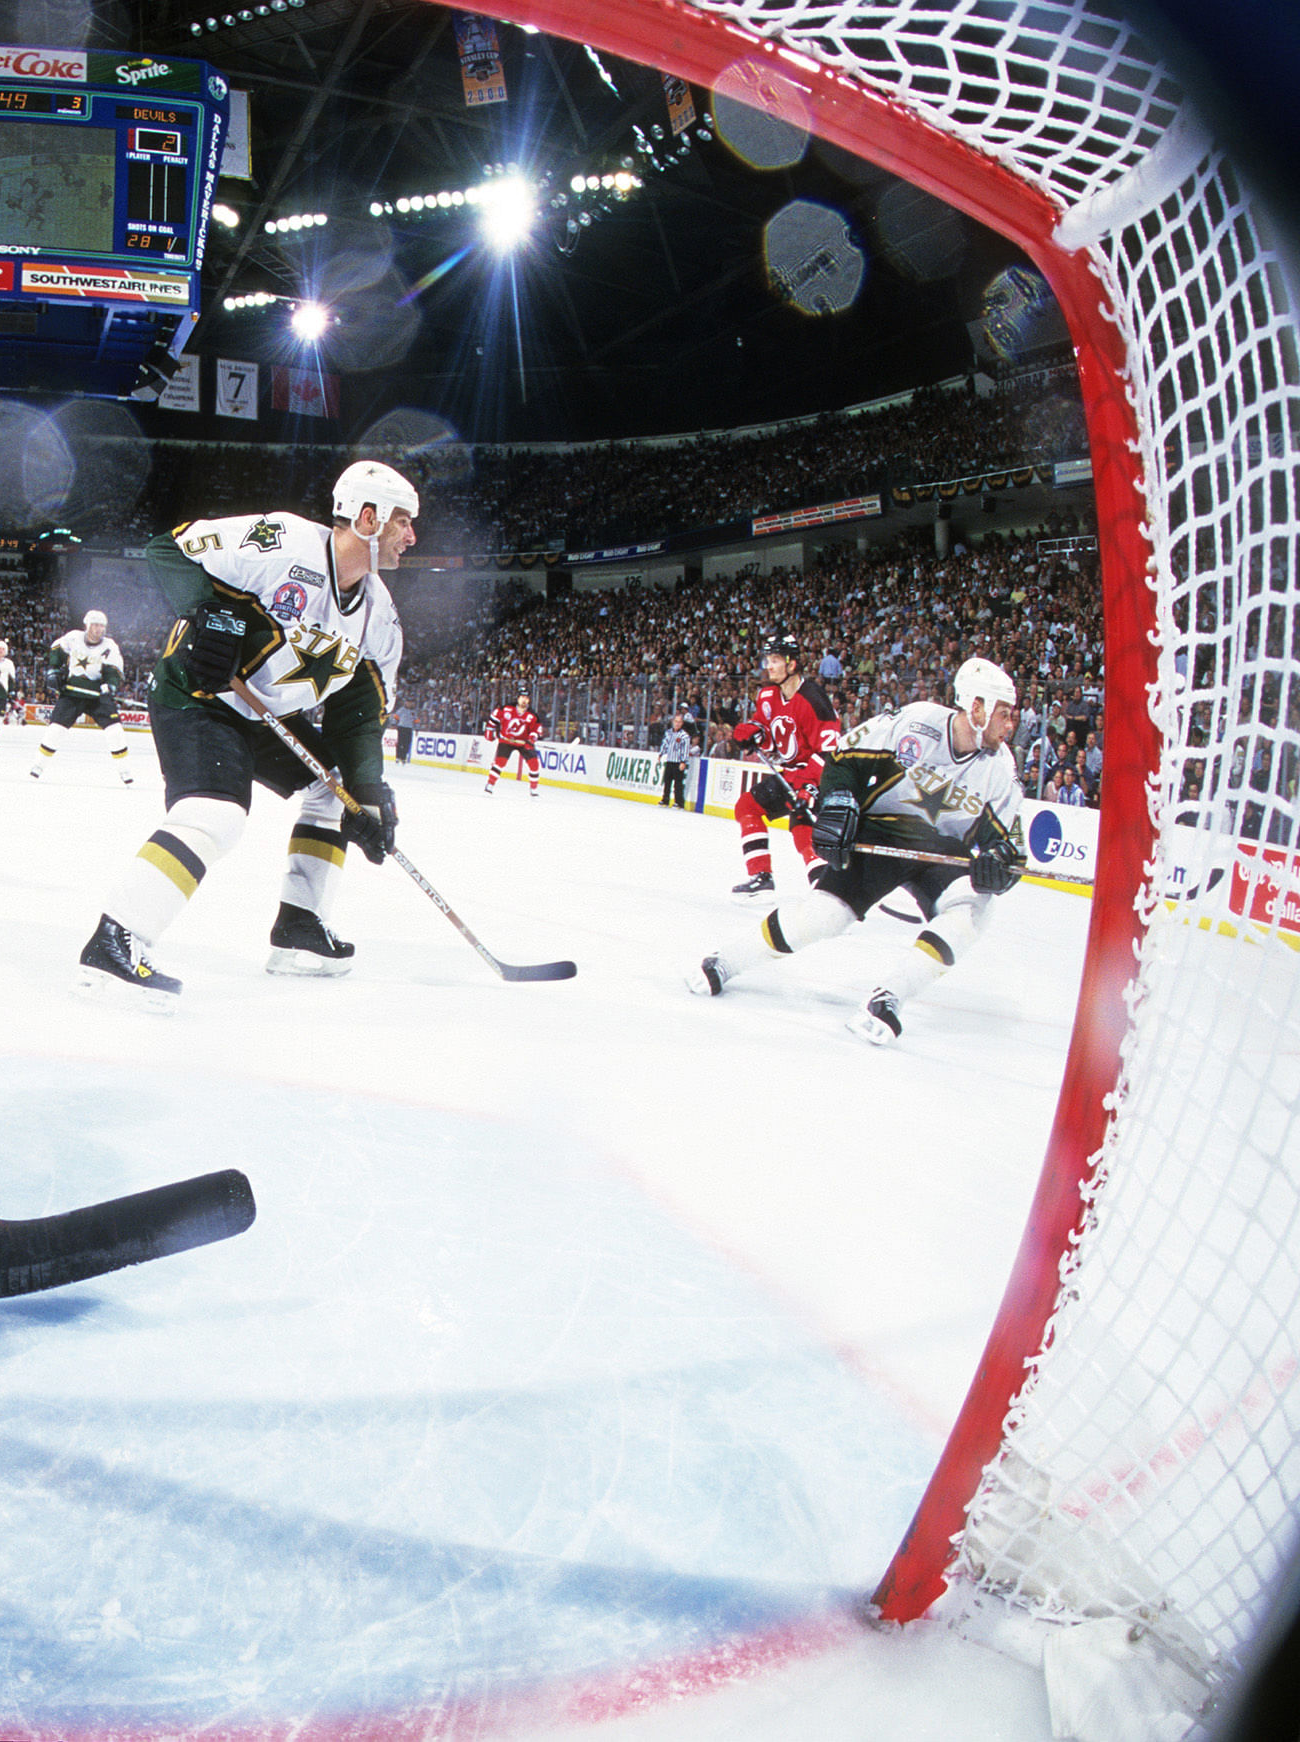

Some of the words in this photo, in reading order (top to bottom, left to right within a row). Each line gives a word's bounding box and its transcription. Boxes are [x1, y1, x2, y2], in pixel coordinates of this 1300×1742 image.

[12, 52, 84, 78] Coke
[116, 63, 169, 85] Sprite
[71, 96, 81, 109] 3
[133, 107, 177, 123] DEVILS
[162, 135, 176, 150] 2
[208, 113, 222, 170] DALLAS
[127, 234, 151, 248] 28
[30, 274, 118, 289] SOUTHWEST
[118, 280, 182, 295] AIRLINES
[227, 372, 246, 399] 7
[183, 532, 223, 556] 5
[289, 624, 360, 674] STAR
[416, 736, 457, 759] GEICO
[537, 749, 587, 775] NOKIA
[606, 752, 649, 785] QUAKER
[1043, 837, 1088, 861] EDS
